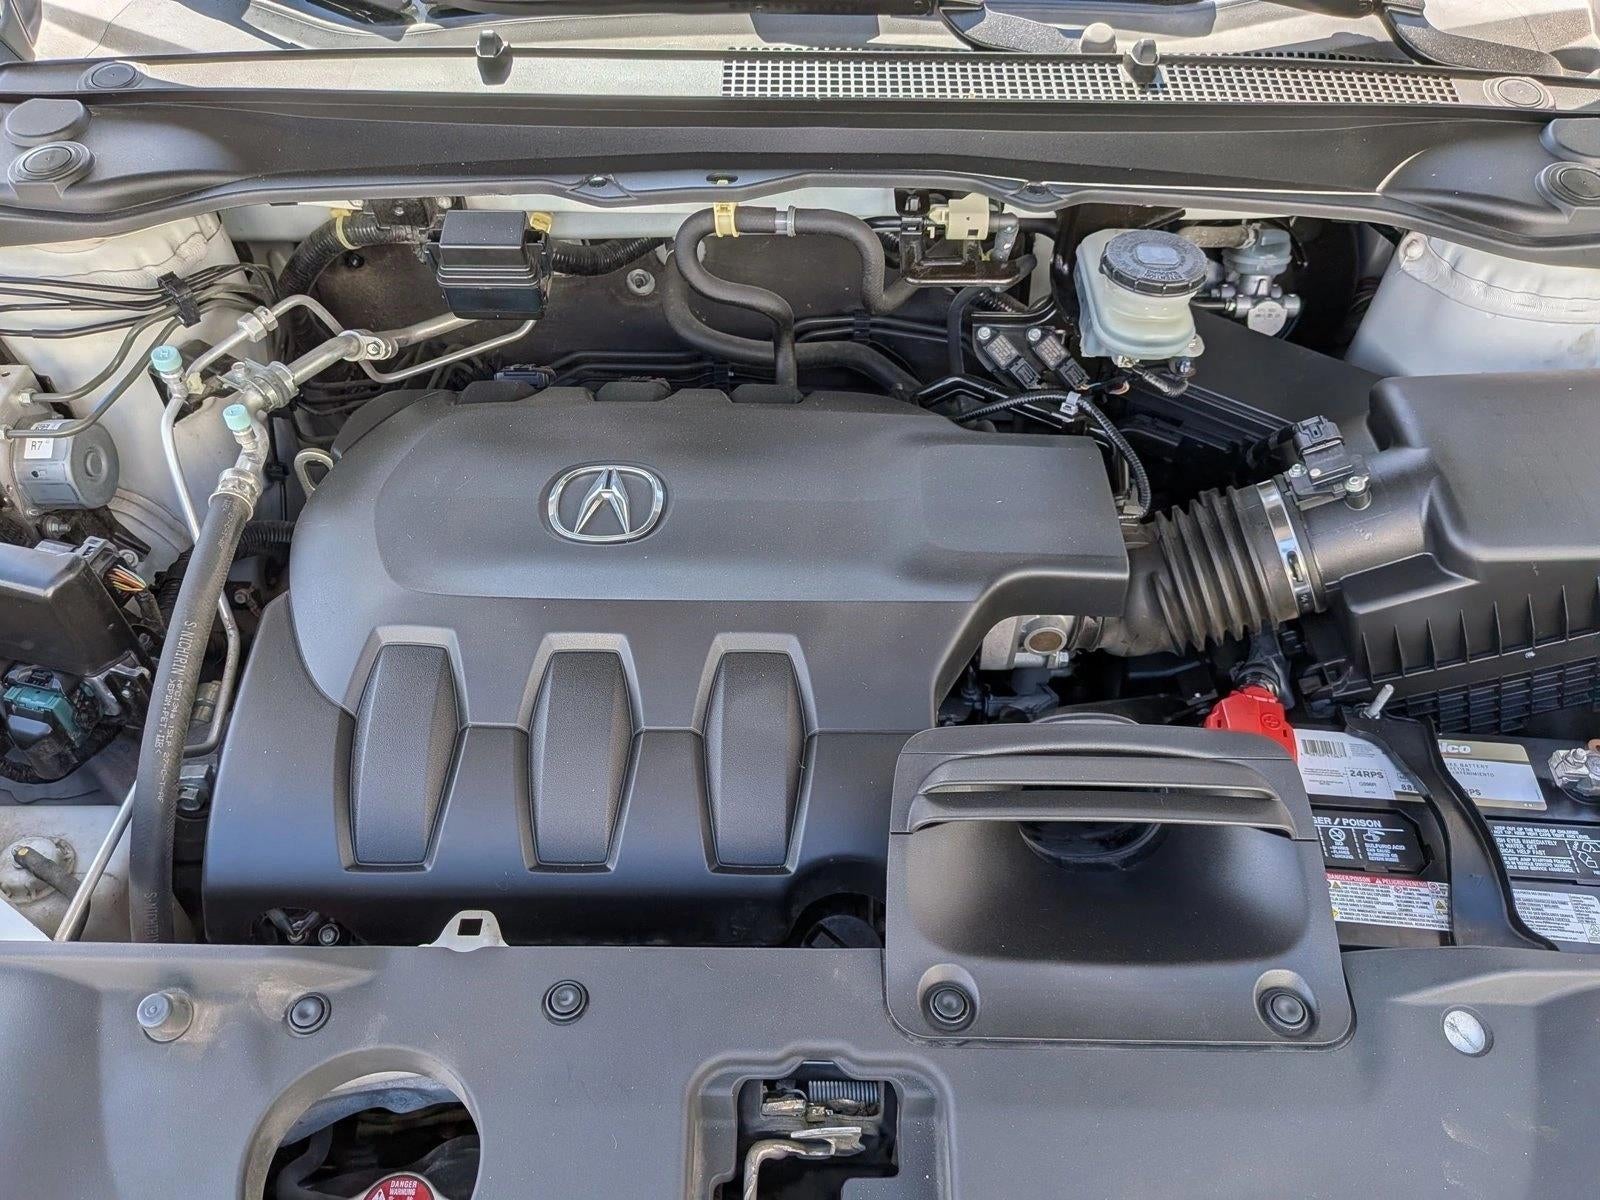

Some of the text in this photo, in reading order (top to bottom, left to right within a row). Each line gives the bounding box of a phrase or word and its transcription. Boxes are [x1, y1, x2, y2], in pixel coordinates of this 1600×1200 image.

[31, 441, 42, 450] R7
[1350, 769, 1384, 779] 24RPS
[1342, 818, 1382, 828] POISON
